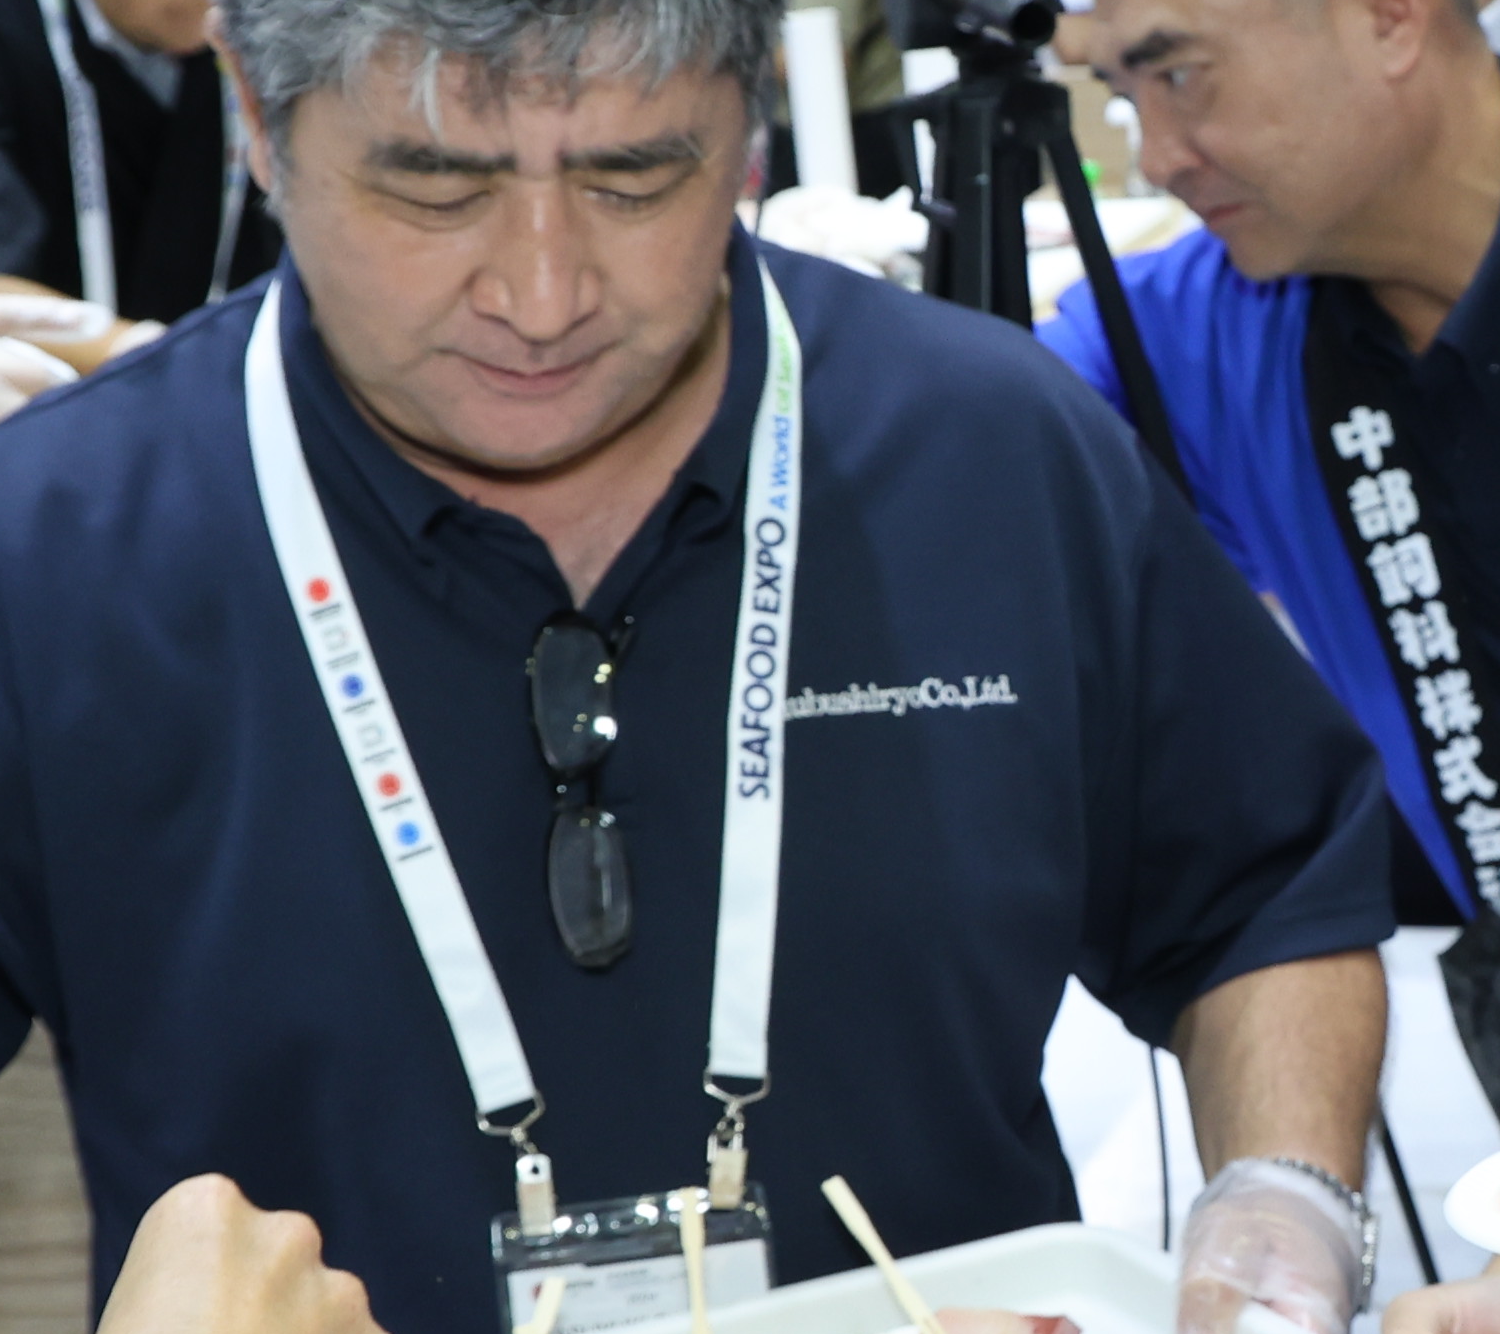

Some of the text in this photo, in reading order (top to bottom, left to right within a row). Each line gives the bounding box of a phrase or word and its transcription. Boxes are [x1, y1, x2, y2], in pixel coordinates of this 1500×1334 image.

[770, 414, 791, 488] World
[769, 493, 788, 511] A
[753, 519, 786, 615] EXPO
[738, 624, 777, 800] SEAFOOD
